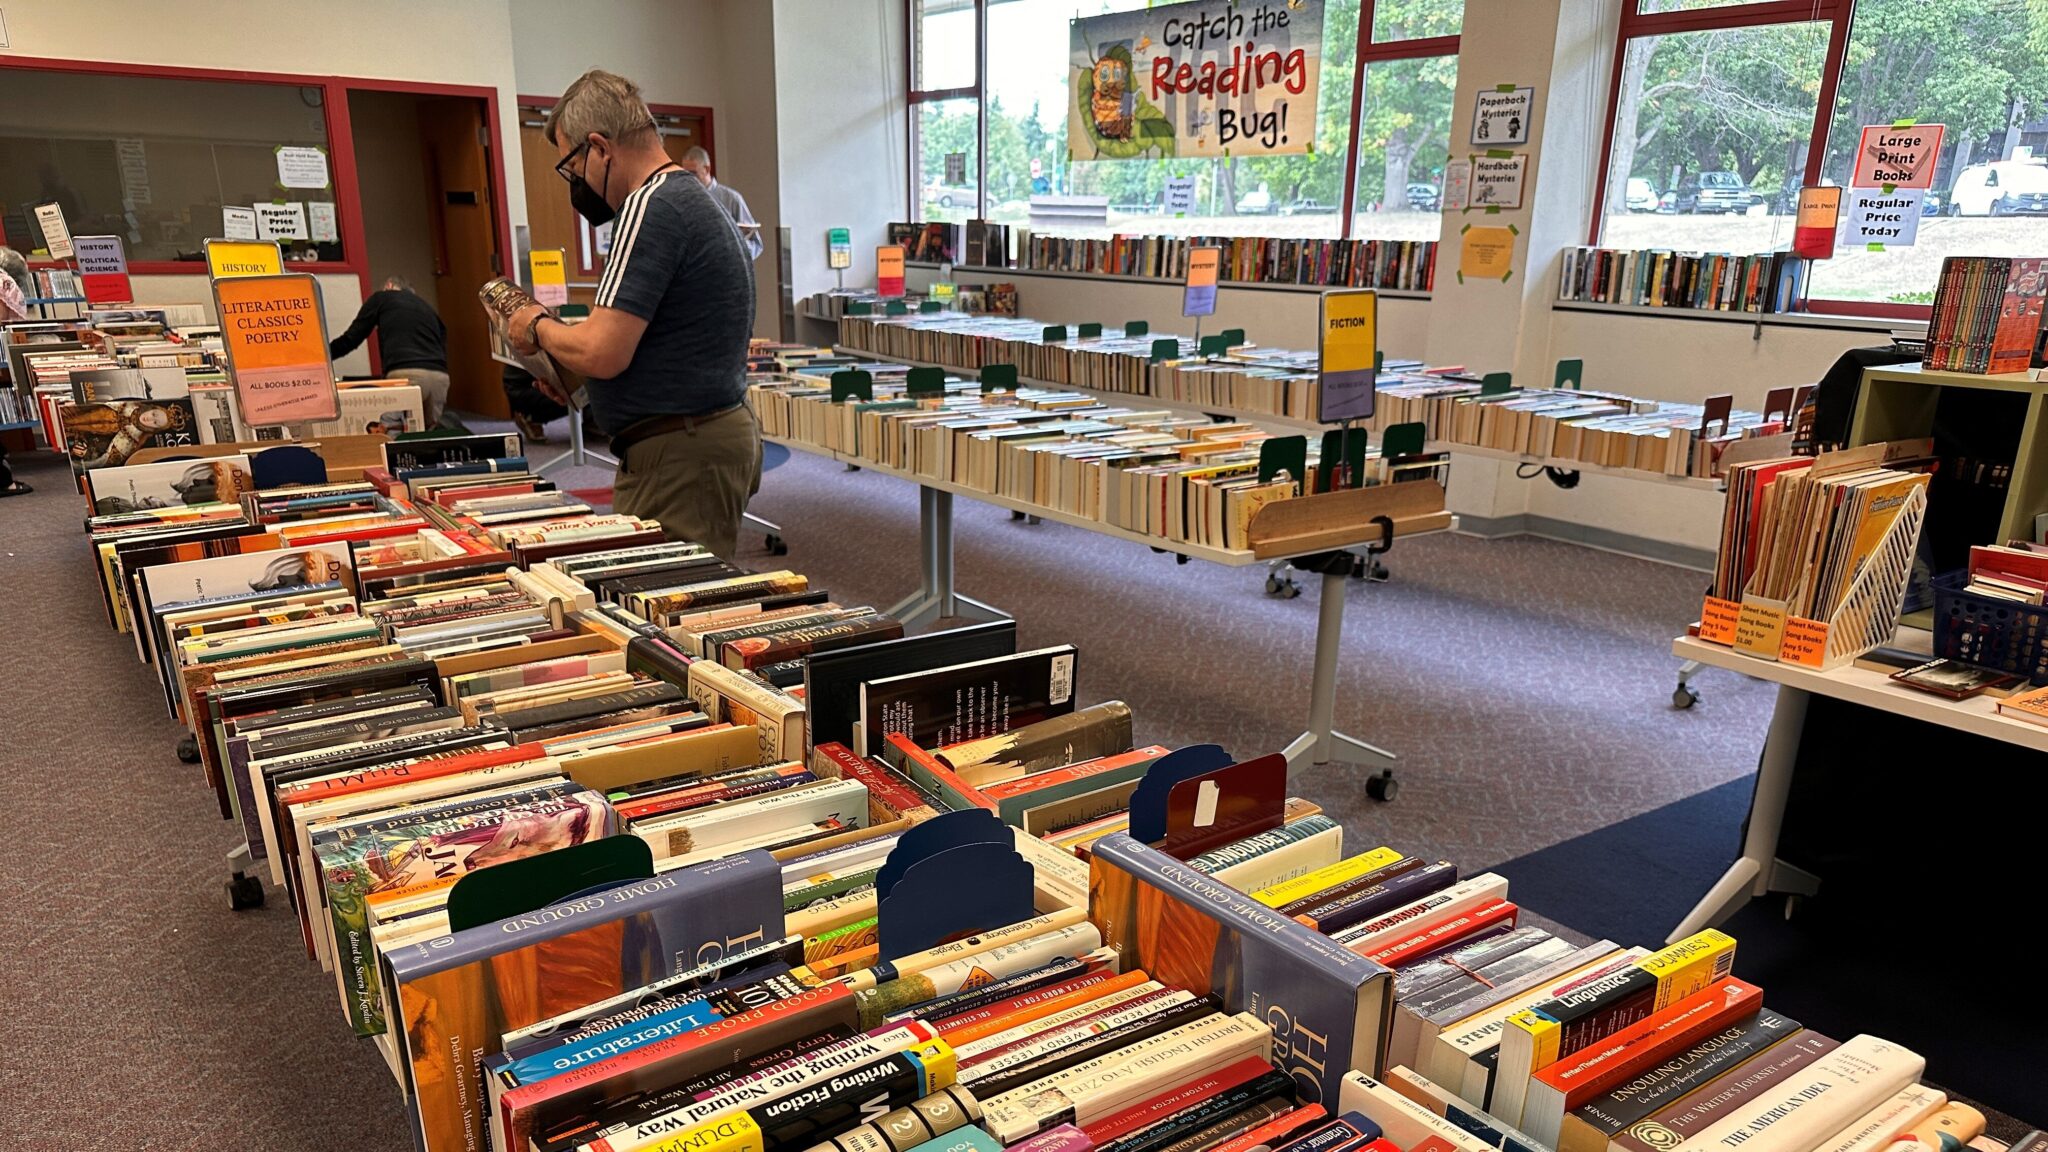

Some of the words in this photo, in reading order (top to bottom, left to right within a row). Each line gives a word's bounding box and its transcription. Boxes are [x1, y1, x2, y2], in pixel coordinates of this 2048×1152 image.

[1163, 6, 1243, 49] Catch
[1252, 9, 1290, 37] the
[1152, 41, 1306, 100] Reading
[1480, 95, 1526, 107] Paperback
[1481, 109, 1520, 119] Mysteries
[1218, 103, 1288, 148] Bug!
[1879, 135, 1921, 148] Large
[1877, 152, 1915, 164] Print
[1477, 162, 1519, 171] Hardback
[1477, 174, 1516, 184] Mysteries
[1873, 169, 1913, 181] Books
[1859, 198, 1914, 210] Regular
[261, 209, 298, 217] Regular
[1865, 212, 1901, 222] Price
[269, 227, 296, 235] Today
[1861, 226, 1901, 238] Today
[222, 263, 267, 273] HISTORY
[223, 297, 311, 315] LITERATURE
[237, 314, 304, 330] CLASSICS
[1330, 316, 1366, 329] FICTION
[245, 330, 300, 345] POETRY
[250, 382, 263, 390] ALL
[265, 380, 290, 389] BOOKS
[292, 378, 312, 388] $2.00
[1706, 599, 1723, 609] Sheet
[1724, 603, 1739, 612] Musi
[1743, 604, 1759, 614] Sheet
[1760, 609, 1780, 619] Music
[1705, 609, 1719, 619] Song
[1720, 613, 1738, 623] Books
[1740, 616, 1755, 626] Song
[1756, 620, 1775, 630] Books
[738, 617, 813, 636] LITERATURE
[1703, 620, 1716, 630] Any
[1788, 619, 1806, 629] Sheet
[1807, 623, 1827, 633] Music
[798, 623, 853, 643] HOLLOW
[1701, 629, 1717, 639] $1.00
[1738, 627, 1750, 637] Any
[1755, 631, 1765, 639] for
[1785, 630, 1802, 640] Song
[1802, 634, 1823, 644] Books
[1736, 636, 1752, 646] $1.00
[1783, 642, 1797, 652] Any
[1803, 646, 1814, 654] for
[1781, 651, 1800, 660] $1.00
[968, 699, 973, 707] to
[377, 715, 422, 727] TOLSTOY
[425, 711, 444, 719] LEO
[980, 724, 985, 733] be
[991, 721, 997, 729] to
[362, 741, 394, 751] OTHER
[288, 749, 351, 764] BEGINNINGS
[727, 779, 781, 795] MURAKAMI
[818, 781, 852, 792] Letters
[758, 797, 782, 806] Wall
[782, 792, 800, 800] The
[432, 797, 518, 818] Howards
[541, 803, 570, 814] THE
[386, 816, 427, 830] End
[431, 811, 539, 836] COLLECTED
[1205, 830, 1280, 868] LANGUAGE
[608, 877, 679, 904] HOME
[1159, 864, 1232, 904] GROUND
[1308, 903, 1338, 918] NOVEL
[1338, 884, 1386, 906] SHORTCUTS
[502, 898, 605, 934] GROUND
[1231, 902, 1288, 934] HOME
[1366, 903, 1428, 933] BREAKOUT
[1427, 894, 1453, 907] NOVEL
[1034, 916, 1054, 927] The
[982, 921, 1034, 941] Gutenberg
[737, 945, 770, 960] WRITING
[928, 944, 964, 957] Elegies
[1380, 948, 1393, 957] GET
[1393, 934, 1427, 953] PUBLISHED
[1654, 938, 1712, 969] DUMMIES
[710, 956, 735, 968] YOUR
[683, 965, 709, 978] FIRST
[657, 973, 682, 987] PLAY
[1074, 975, 1106, 990] THERE'S
[735, 983, 770, 1010] 101
[1041, 988, 1064, 1000] WORD
[1557, 972, 1632, 1009] Linguistics
[772, 986, 833, 1012] GOOD
[1013, 1001, 1023, 1009] IT
[1023, 996, 1040, 1005] FOR
[1154, 997, 1181, 1010] WHY
[955, 1002, 981, 1013] GEORGE
[977, 1010, 991, 1019] SOL
[931, 1010, 953, 1020] BOOTH
[1113, 1010, 1143, 1025] READ
[698, 1010, 764, 1038] PROSE
[936, 1015, 977, 1032] STEINMETZ
[1190, 1016, 1223, 1030] IRONS
[881, 1031, 911, 1043] Rico
[1172, 1029, 1185, 1037] IN
[1191, 1024, 1243, 1047] BRITISH
[1454, 1019, 1506, 1046] STEVEN
[552, 1013, 703, 1070] Literature
[797, 1032, 841, 1051] Terry
[1040, 1031, 1087, 1052] WENDY
[1147, 1034, 1170, 1046] THE
[1118, 1044, 1144, 1057] FIRE
[1135, 1042, 1193, 1069] ENGLISH
[749, 1049, 794, 1067] Gross
[804, 1044, 881, 1075] Writing
[989, 1049, 1035, 1071] LESSER
[1609, 1059, 1684, 1103] ENSOULING
[1681, 1026, 1748, 1064] LANGUAGE
[1075, 1059, 1103, 1074] JOHN
[715, 1070, 732, 1080] All
[769, 1068, 806, 1088] the
[830, 1061, 901, 1093] Writing
[1029, 1072, 1070, 1091] McPHEE
[686, 1079, 708, 1093] Did
[1069, 1078, 1103, 1094] ZED
[1203, 1079, 1220, 1089] THE
[449, 1035, 461, 1064] Debra
[463, 1110, 476, 1152] Managing
[661, 1088, 686, 1101] Was
[1181, 1085, 1204, 1100] STORY
[1669, 1108, 1699, 1127] THE
[1691, 1085, 1741, 1115] WRITER'S
[1734, 1064, 1780, 1093] JOURNEY
[638, 1097, 660, 1110] Ask
[686, 1083, 770, 1121] Natural
[765, 1088, 832, 1119] Fiction
[929, 1101, 950, 1116] 3
[1150, 1095, 1181, 1112] FACTOR
[1113, 1109, 1147, 1127] ANNETTE
[1720, 1124, 1757, 1148] THE
[1752, 1094, 1805, 1134] AMERICAN
[1801, 1081, 1833, 1104] IDEA
[636, 1116, 686, 1141] Way
[1307, 1124, 1352, 1147] Grammar
[860, 1131, 878, 1150] JOHN
